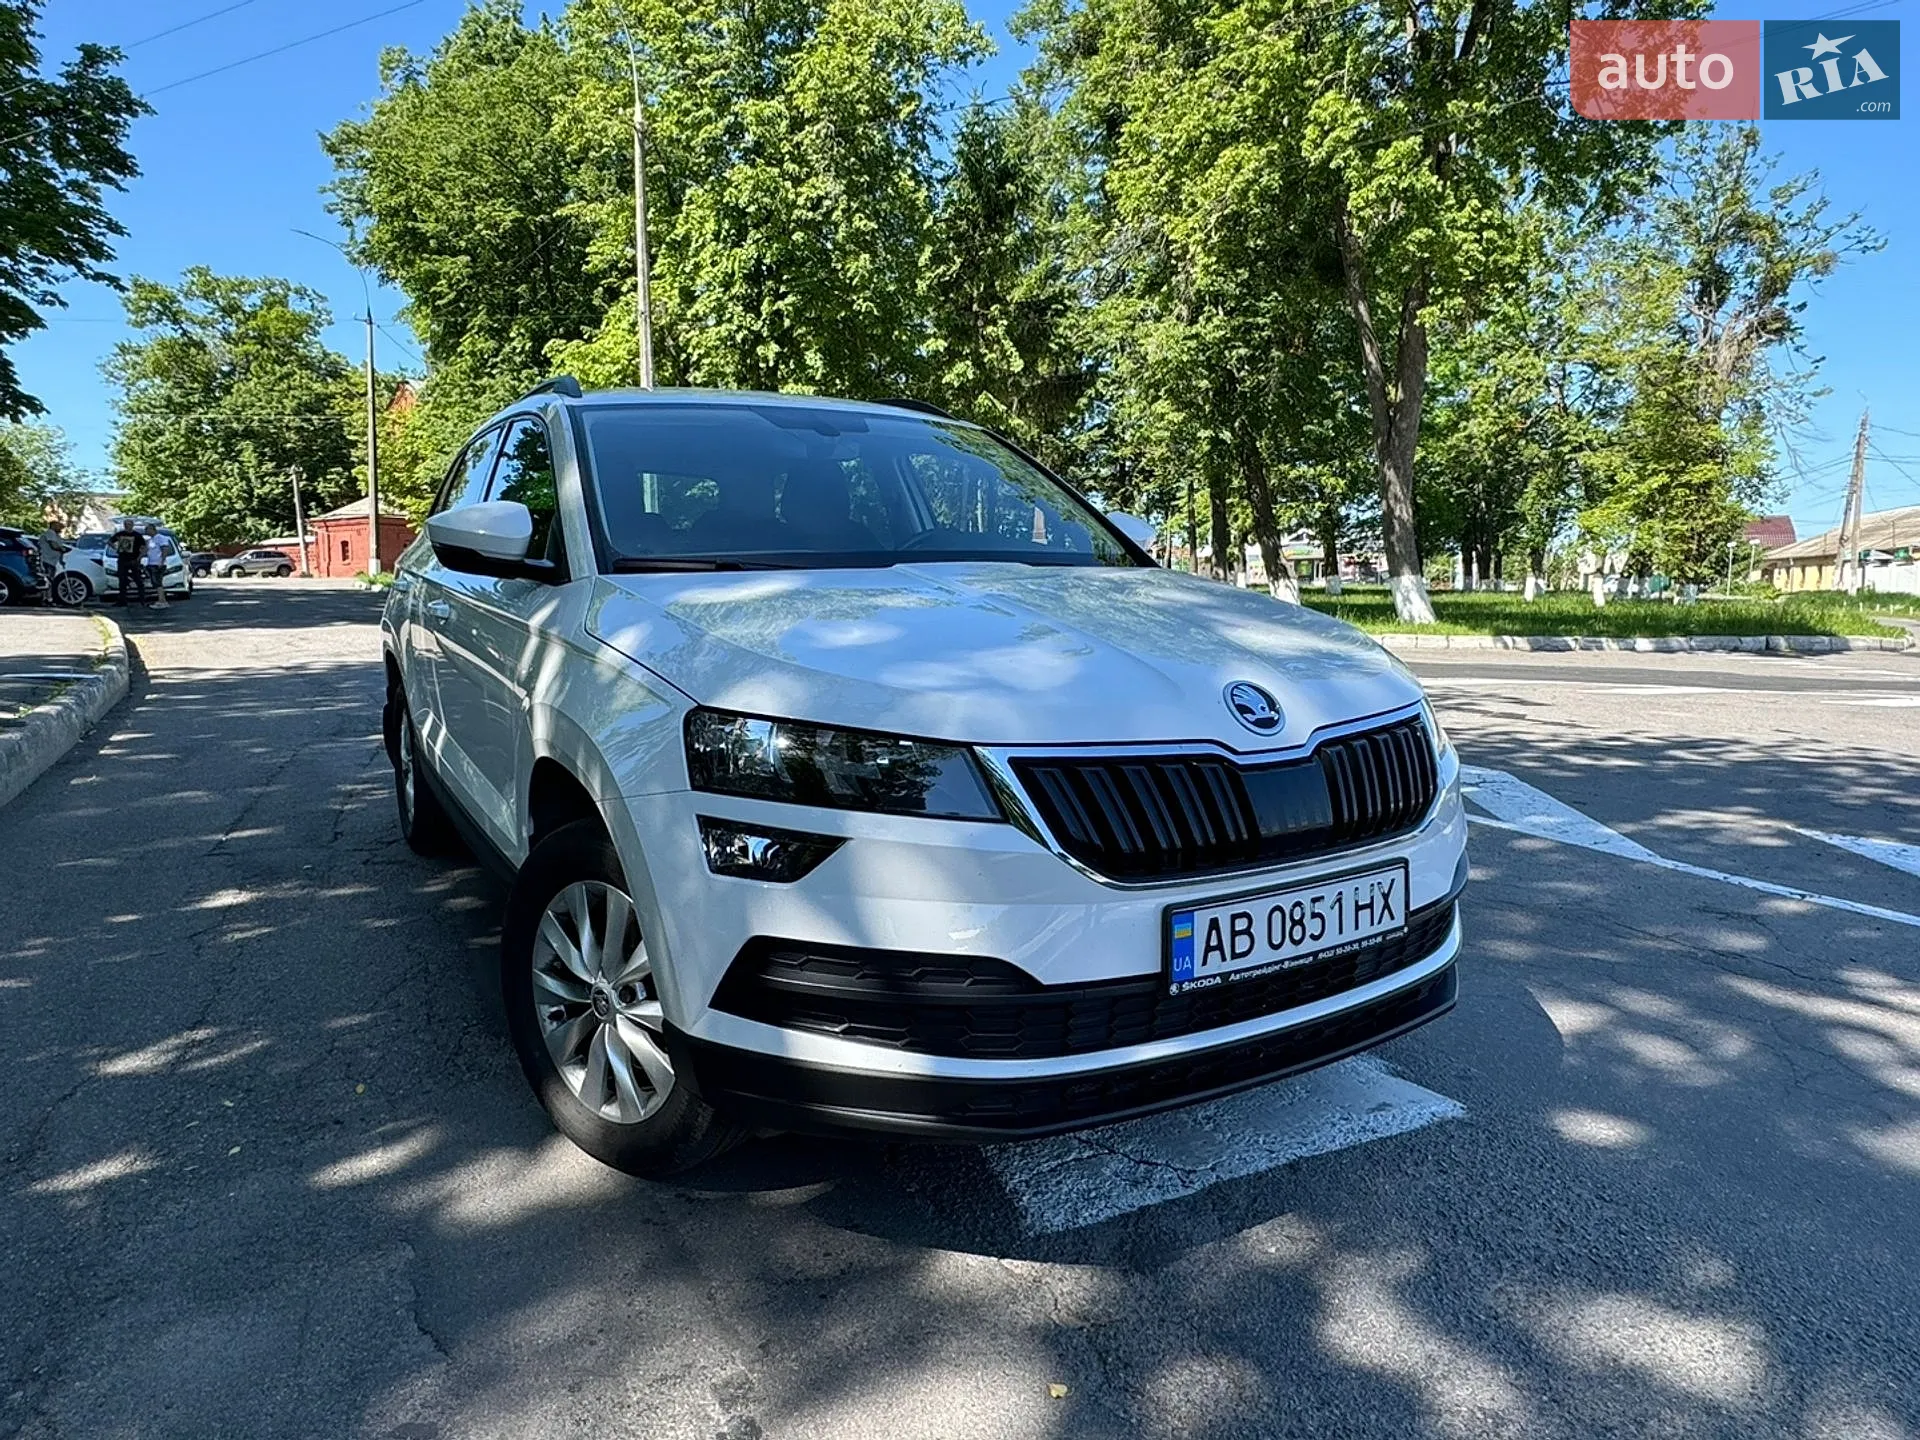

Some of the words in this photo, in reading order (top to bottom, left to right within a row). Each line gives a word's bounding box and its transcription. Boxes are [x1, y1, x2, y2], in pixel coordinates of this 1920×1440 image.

[1201, 911, 1255, 967] AB
[1267, 891, 1344, 951] 0851
[1354, 878, 1396, 931] HX
[1173, 955, 1192, 972] UA
